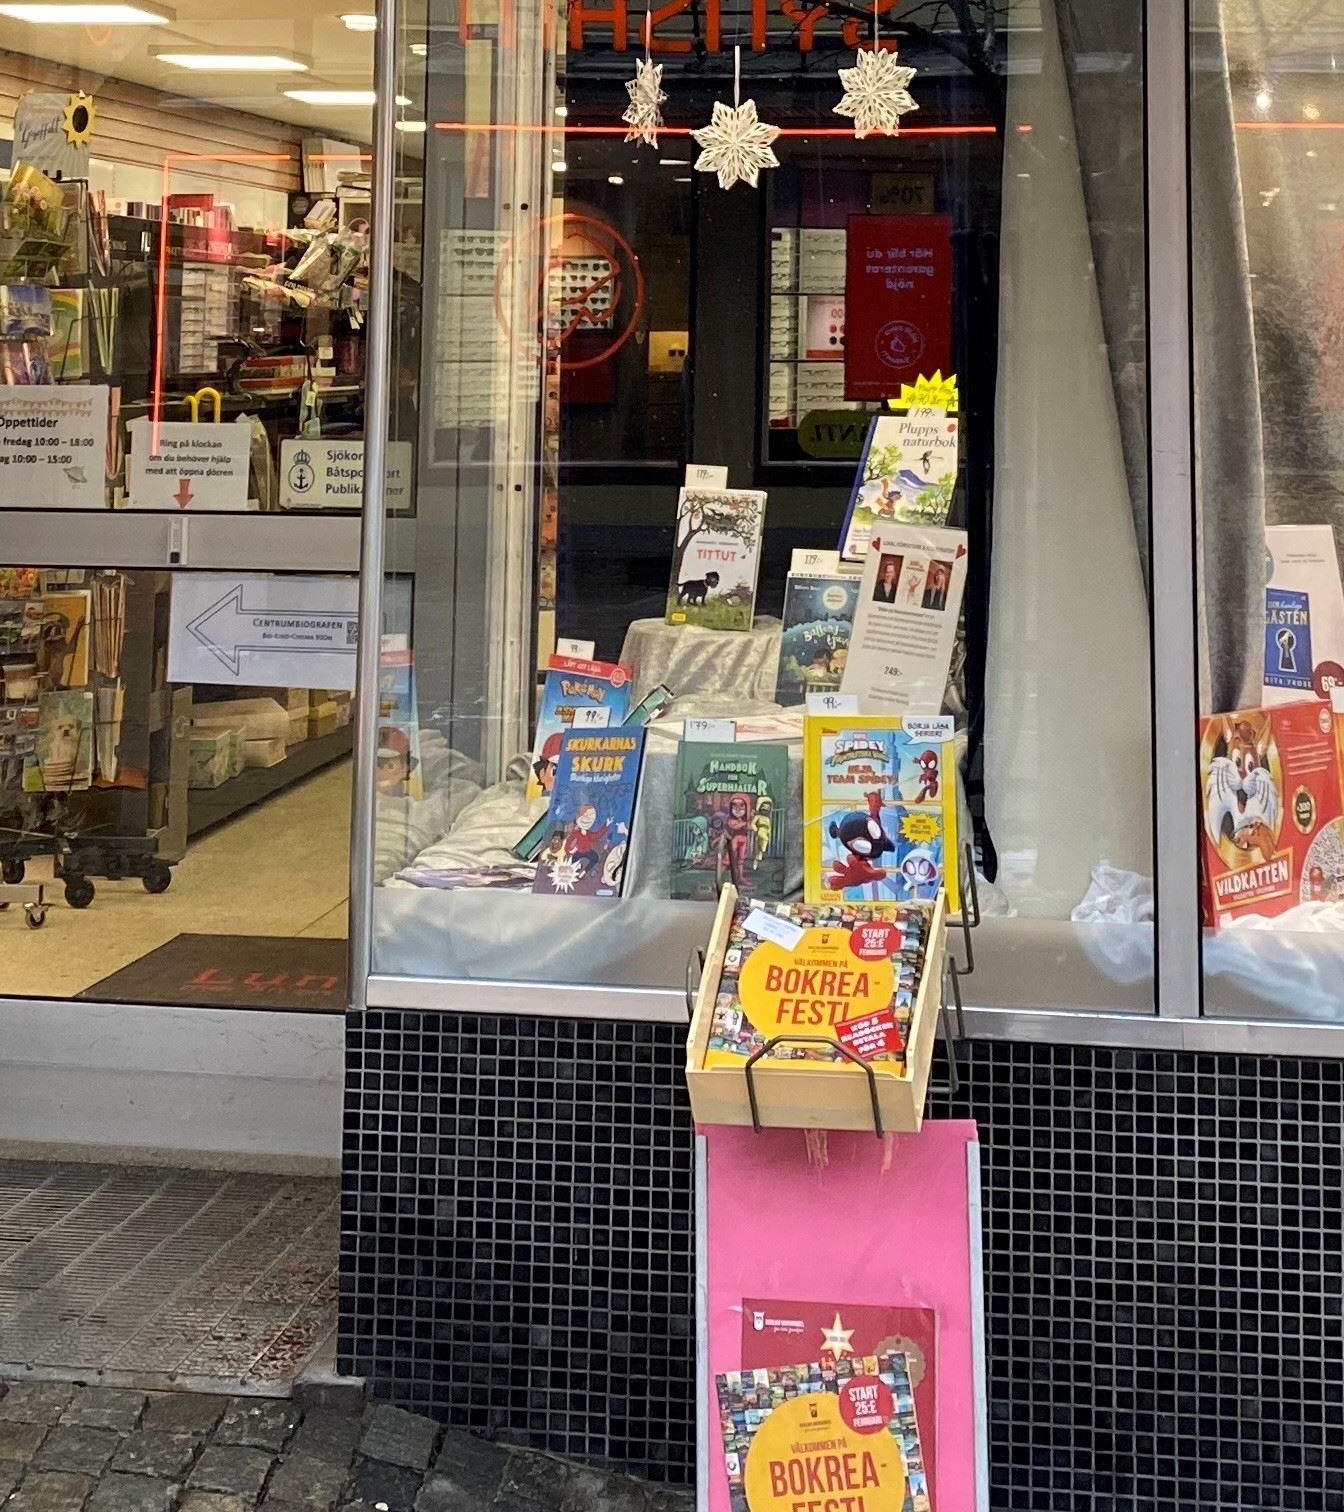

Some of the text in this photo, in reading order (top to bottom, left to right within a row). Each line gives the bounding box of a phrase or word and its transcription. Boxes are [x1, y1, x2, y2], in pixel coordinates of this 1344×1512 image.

[897, 422, 940, 436] Plupps
[3, 436, 32, 448] fredag
[34, 437, 60, 447] 10:00
[179, 439, 191, 450] på
[191, 439, 223, 449] klockan
[902, 437, 957, 448] naturbok
[12, 454, 38, 464] 10:00
[163, 454, 175, 462] du
[211, 454, 232, 465] hjälp
[326, 449, 364, 464] Sjökor
[165, 467, 178, 476] att
[179, 467, 204, 478] öppna
[325, 483, 363, 495] Publik
[696, 549, 737, 562] TITTUT
[834, 739, 885, 754] SPIDEY
[571, 755, 626, 773] SKURK
[709, 759, 758, 776] HANDBOK
[826, 773, 856, 785] TEAM
[1215, 857, 1290, 898] VILDKATTEN
[861, 928, 891, 938] START
[794, 958, 849, 969] VÄLKOMMEN PÅ
[848, 1384, 878, 1402] START
[790, 1436, 848, 1454] VÄLKOMMEN PÅ
